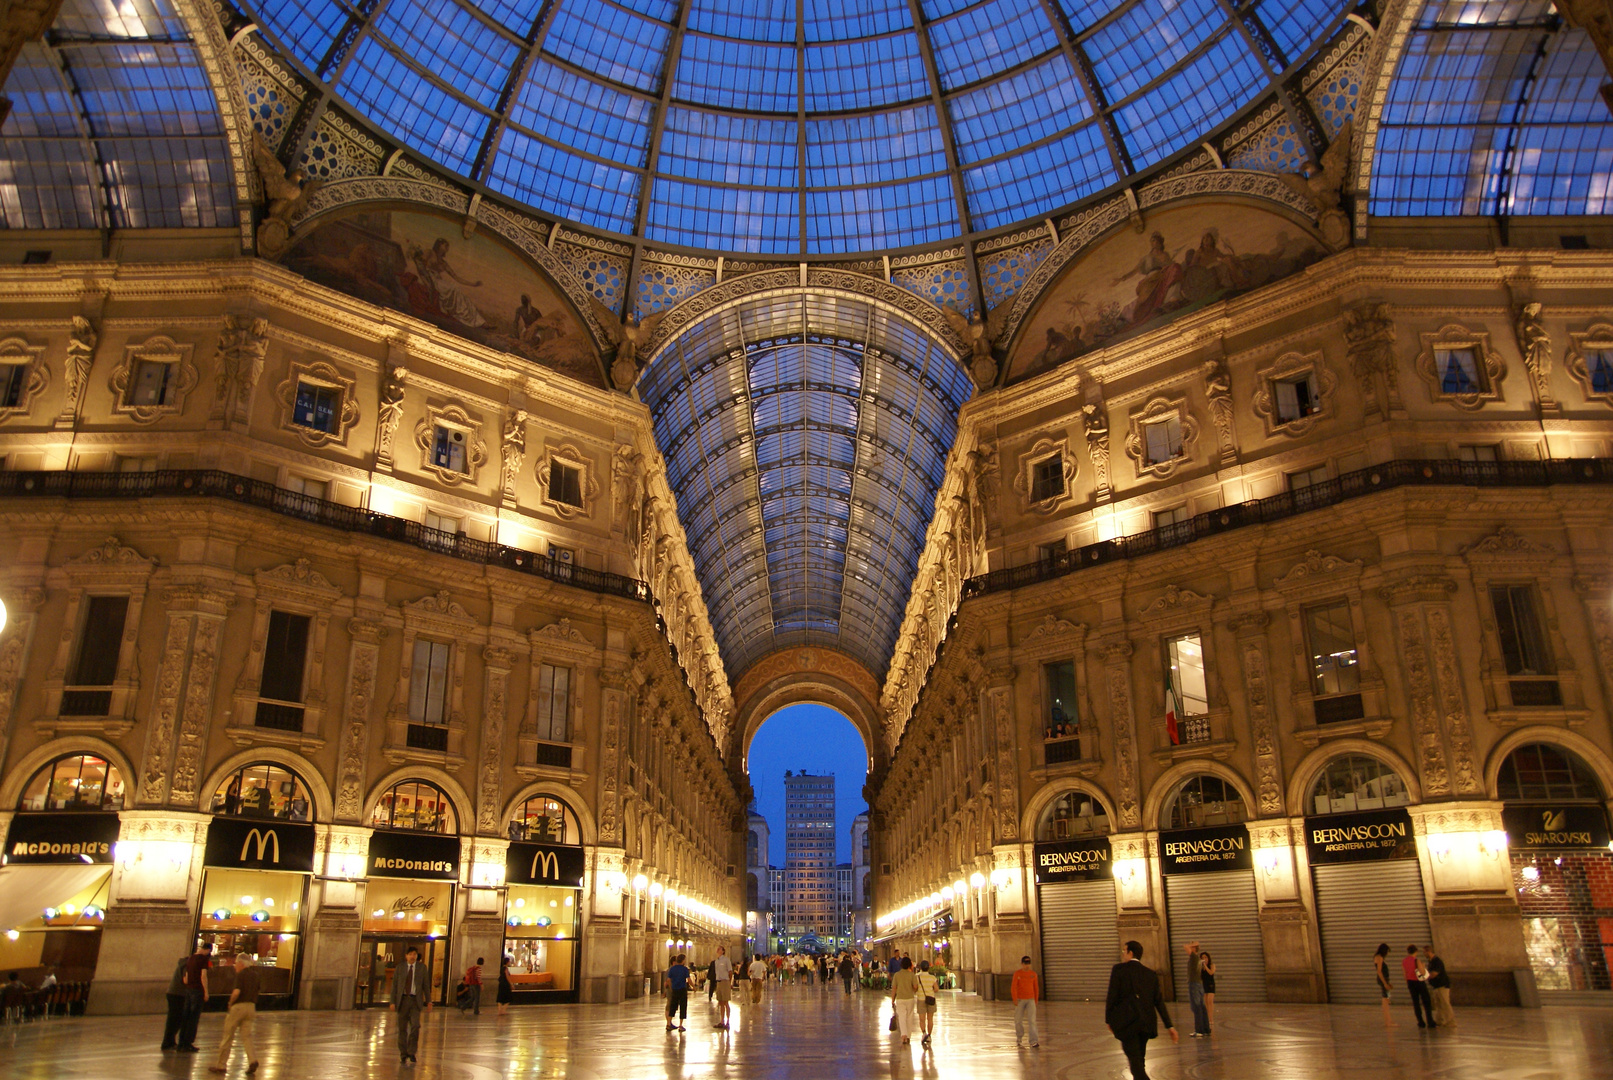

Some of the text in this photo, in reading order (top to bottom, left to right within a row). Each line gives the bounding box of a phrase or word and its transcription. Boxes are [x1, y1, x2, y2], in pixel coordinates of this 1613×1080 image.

[1313, 822, 1406, 844] BERNASCONI
[1525, 832, 1592, 844] SWAROVSKI
[13, 842, 109, 855] McDonald's
[1165, 837, 1244, 856] BERNASCONI
[1325, 839, 1396, 852] ARGENTERIA DAL 1872
[1040, 849, 1107, 867] BERNASCONI
[1175, 852, 1236, 863] ARGENTERIA DAL 1872
[374, 857, 452, 872] McDonald's
[1048, 865, 1077, 873] ARGENTERIA
